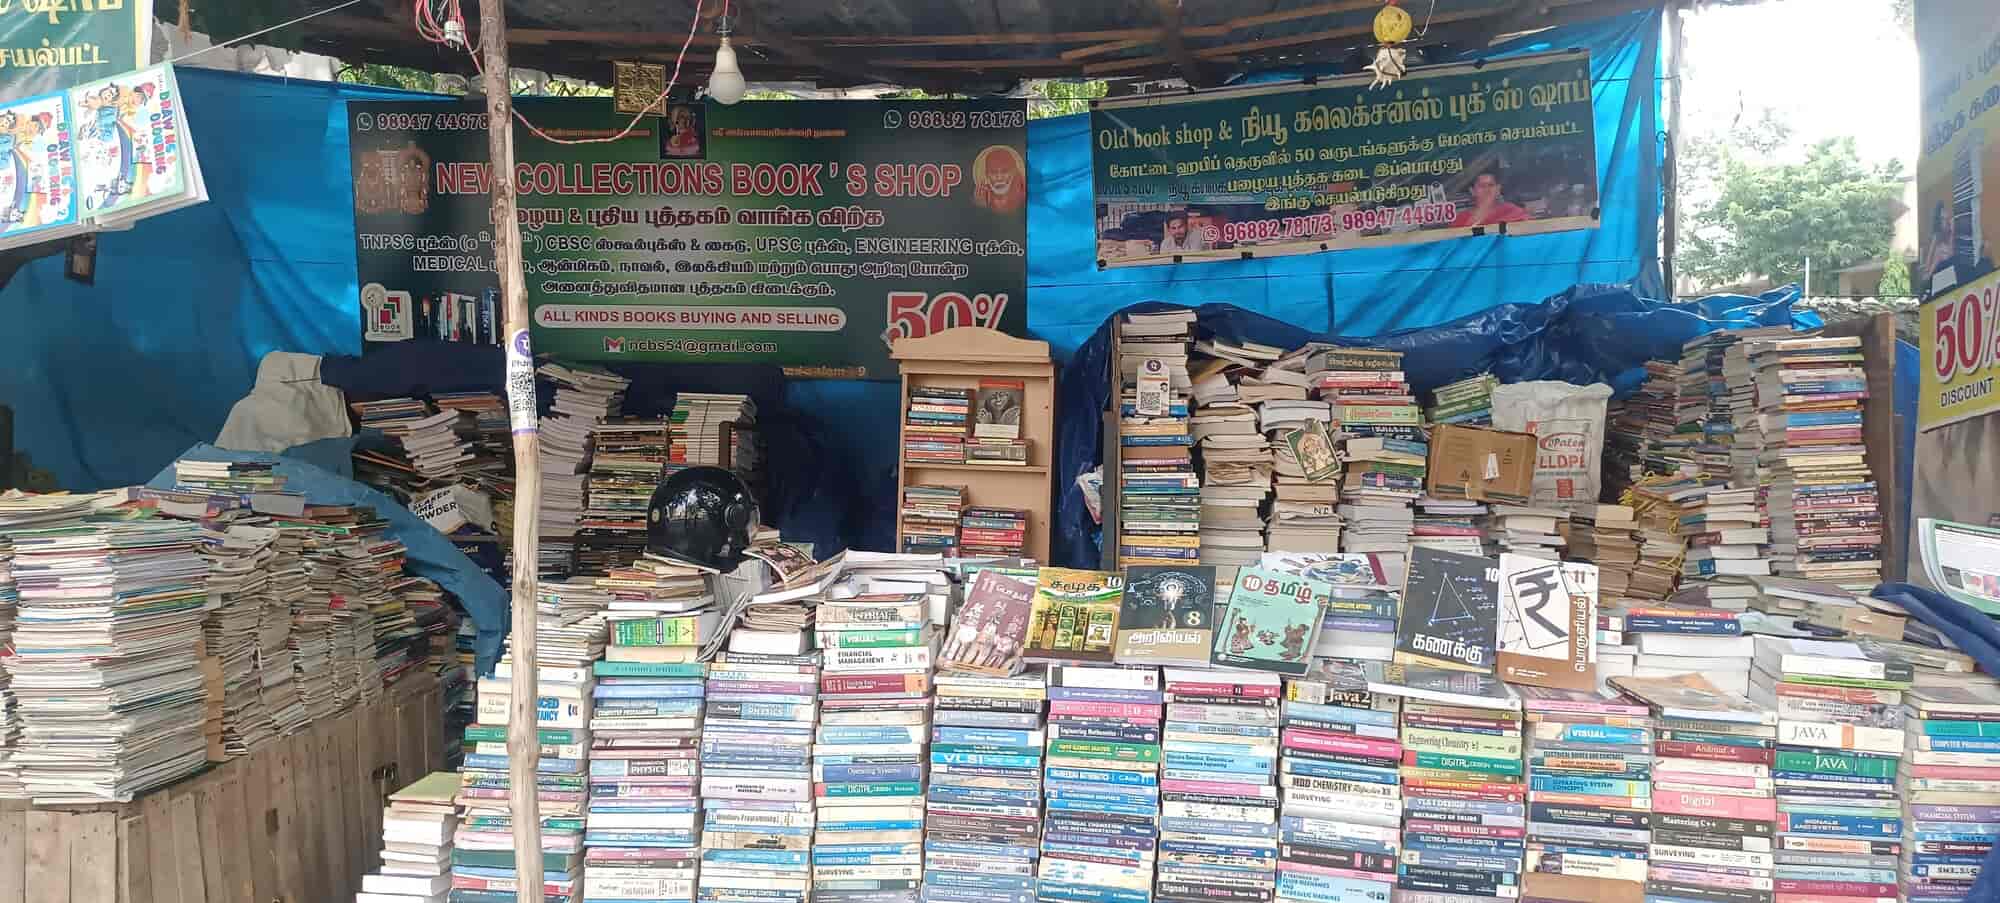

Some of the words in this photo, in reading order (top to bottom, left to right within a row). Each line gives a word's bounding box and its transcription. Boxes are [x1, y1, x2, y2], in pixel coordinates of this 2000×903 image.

[377, 113, 432, 130] 98947
[435, 113, 488, 130] 44678
[907, 111, 965, 128] 96882
[970, 111, 1025, 128] 78173
[1100, 126, 1129, 150] Old
[1133, 125, 1171, 149] book
[1176, 121, 1213, 150] shop
[1218, 119, 1233, 142] &
[1240, 105, 1288, 146] நியூ
[1295, 147, 1315, 162] 50
[515, 162, 723, 196] COLLECTIONS
[731, 163, 823, 197] BOOK
[846, 163, 868, 197] S
[875, 163, 962, 198] SHOP
[568, 207, 583, 225] &
[586, 207, 639, 229] புதிய
[1223, 220, 1280, 242] 96882
[1342, 209, 1396, 231] 98947
[1402, 203, 1457, 225] 44678
[359, 233, 415, 250] TNPSC
[546, 234, 593, 251] CBSC
[690, 238, 702, 251] &
[756, 237, 801, 253] UPSC
[855, 238, 972, 254] ENGINEERING
[413, 254, 489, 271] MEDICAL
[543, 311, 571, 322] ALL
[575, 311, 620, 323] KINDS
[625, 311, 674, 324] BOOKS
[680, 312, 737, 325] BUYING
[740, 313, 774, 325] AND
[777, 313, 841, 326] SELLING
[629, 338, 778, 355] ncbs54@gmail.com
[1940, 377, 1993, 408] DISCOUNT
[1105, 575, 1122, 588] 10
[1484, 567, 1498, 583] 10
[1187, 611, 1201, 626] 8
[1412, 631, 1483, 665] கணக்கு
[1328, 688, 1358, 703] Java
[1359, 690, 1370, 704] 2
[1791, 726, 1828, 741] JAVA
[942, 754, 983, 764] VLSI
[1814, 755, 1849, 770] JAVA
[1312, 776, 1353, 793] CHEMISTRY
[1680, 793, 1714, 807] Digital
[1654, 849, 1696, 859] SURVEYING
[1161, 882, 1189, 893] Signals
[1203, 888, 1233, 899] Systems
